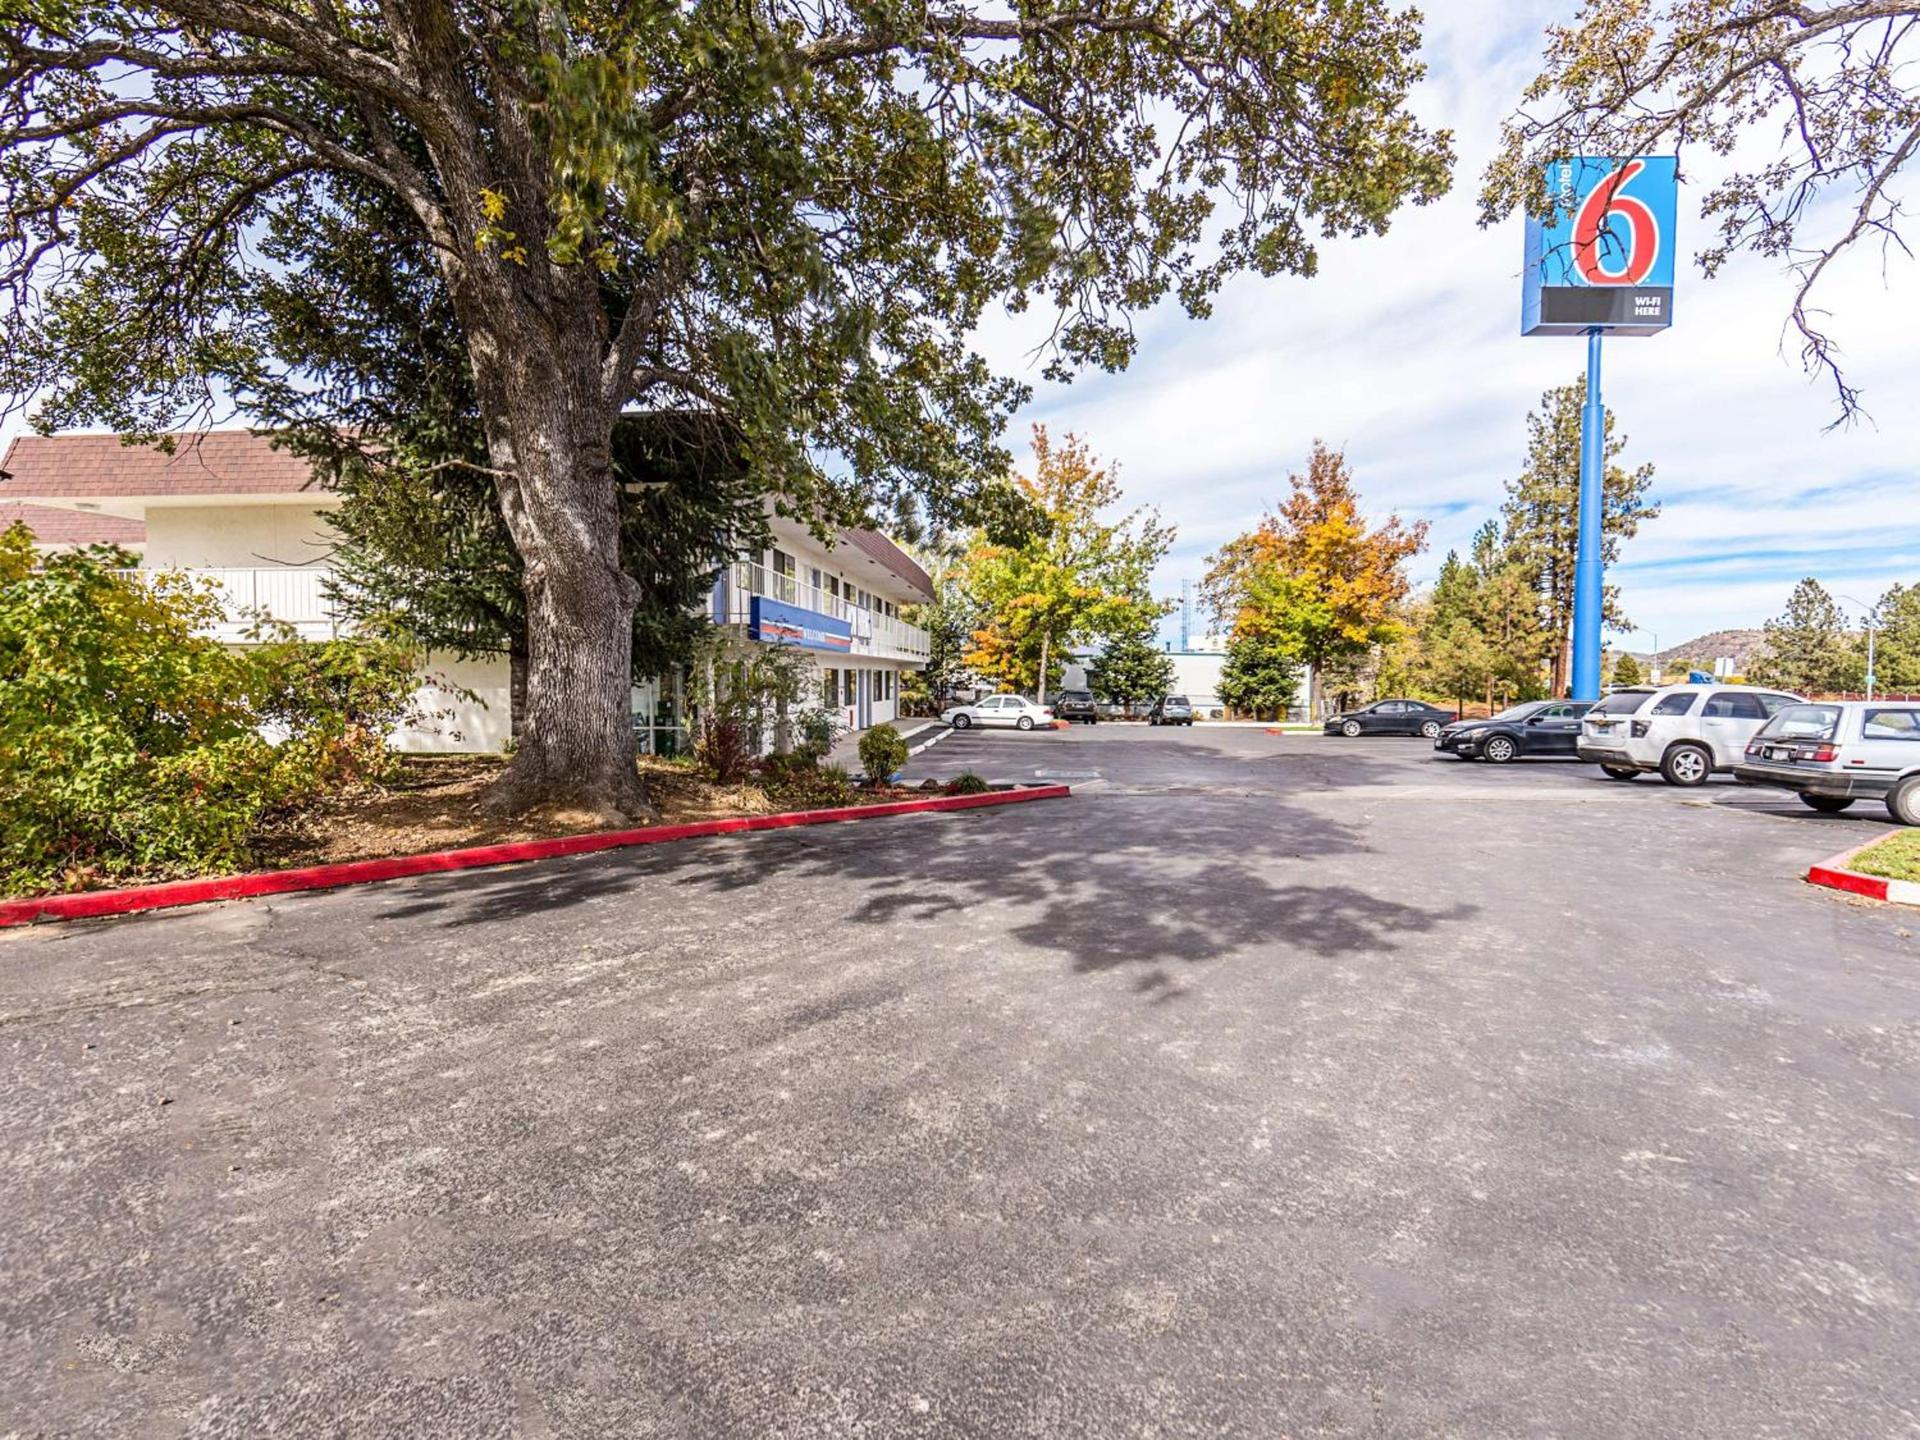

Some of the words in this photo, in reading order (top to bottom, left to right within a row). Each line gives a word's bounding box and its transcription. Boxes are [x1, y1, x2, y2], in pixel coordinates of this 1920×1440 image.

[1571, 159, 1659, 286] 6
[1635, 297, 1661, 306] WI-FI
[1634, 307, 1661, 316] HERE
